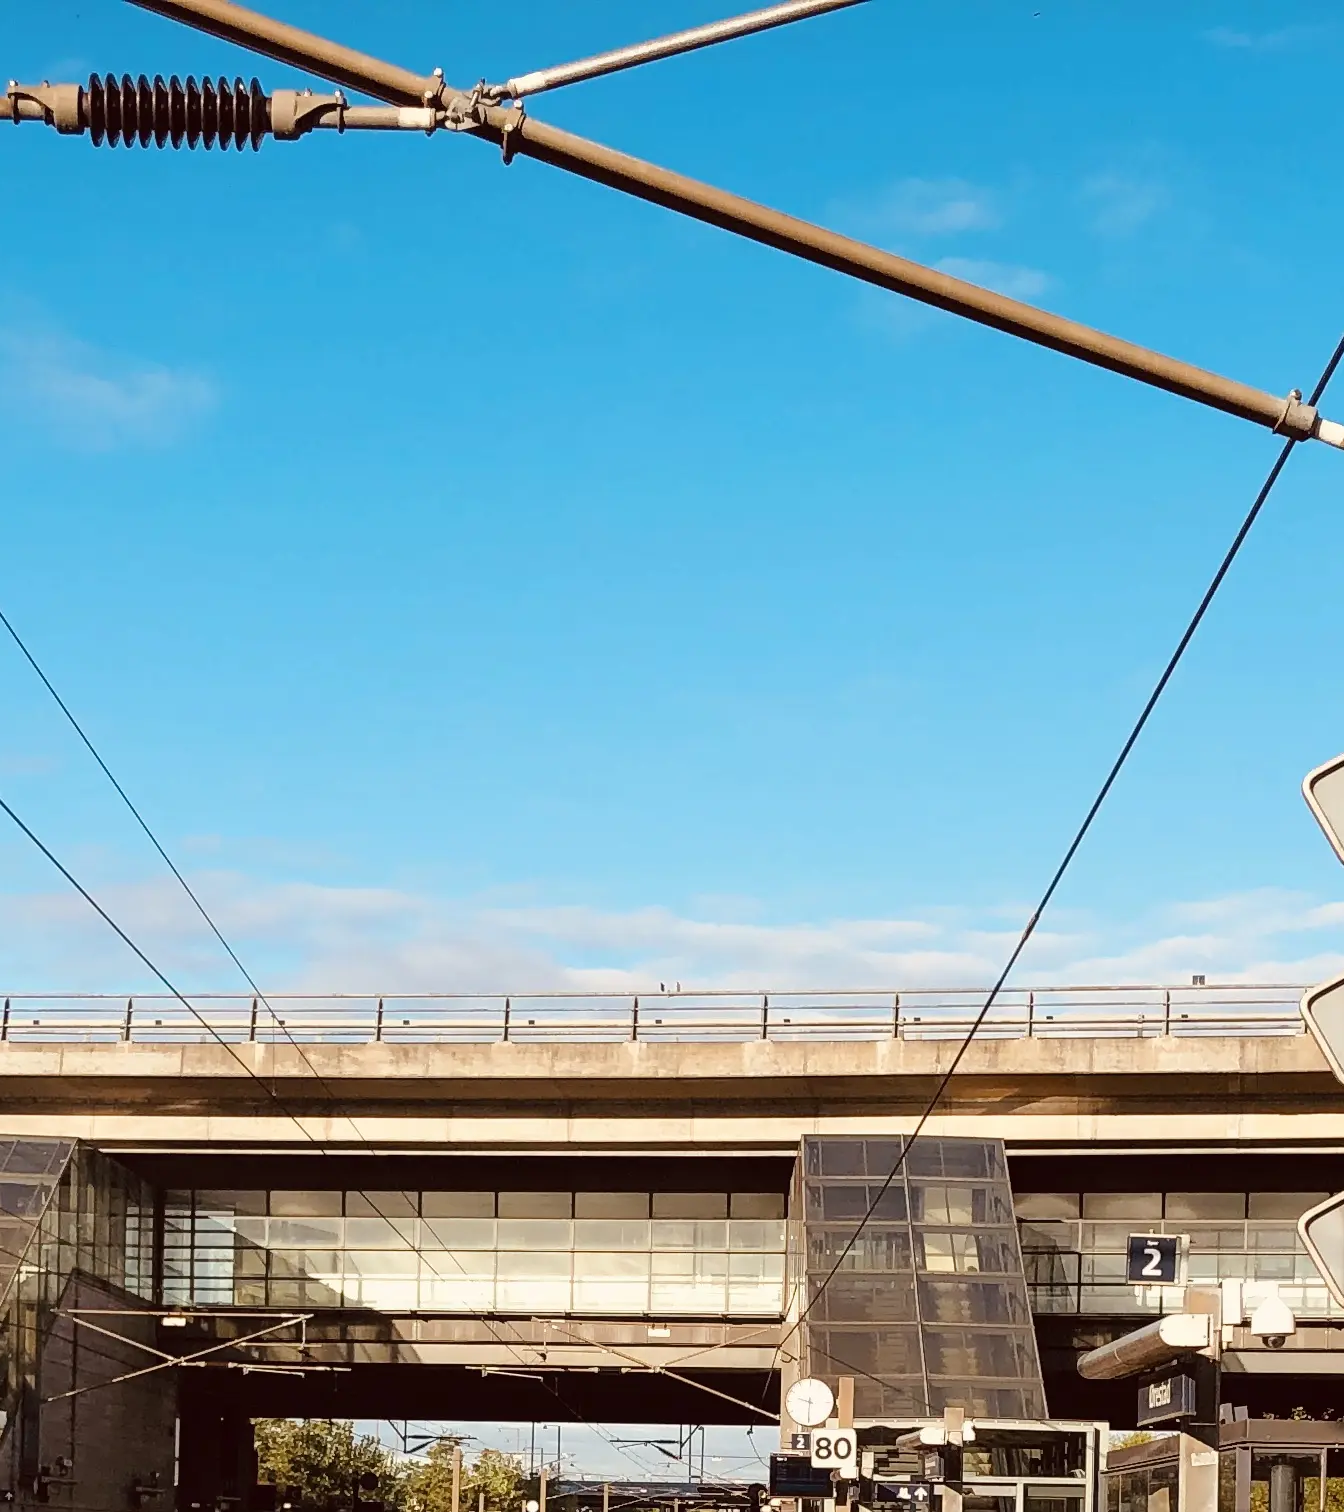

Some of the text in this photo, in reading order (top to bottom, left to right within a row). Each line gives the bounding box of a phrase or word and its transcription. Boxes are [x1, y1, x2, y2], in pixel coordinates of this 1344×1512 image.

[1141, 1248, 1162, 1276] 2
[796, 1437, 805, 1449] 2
[815, 1437, 852, 1460] 80
